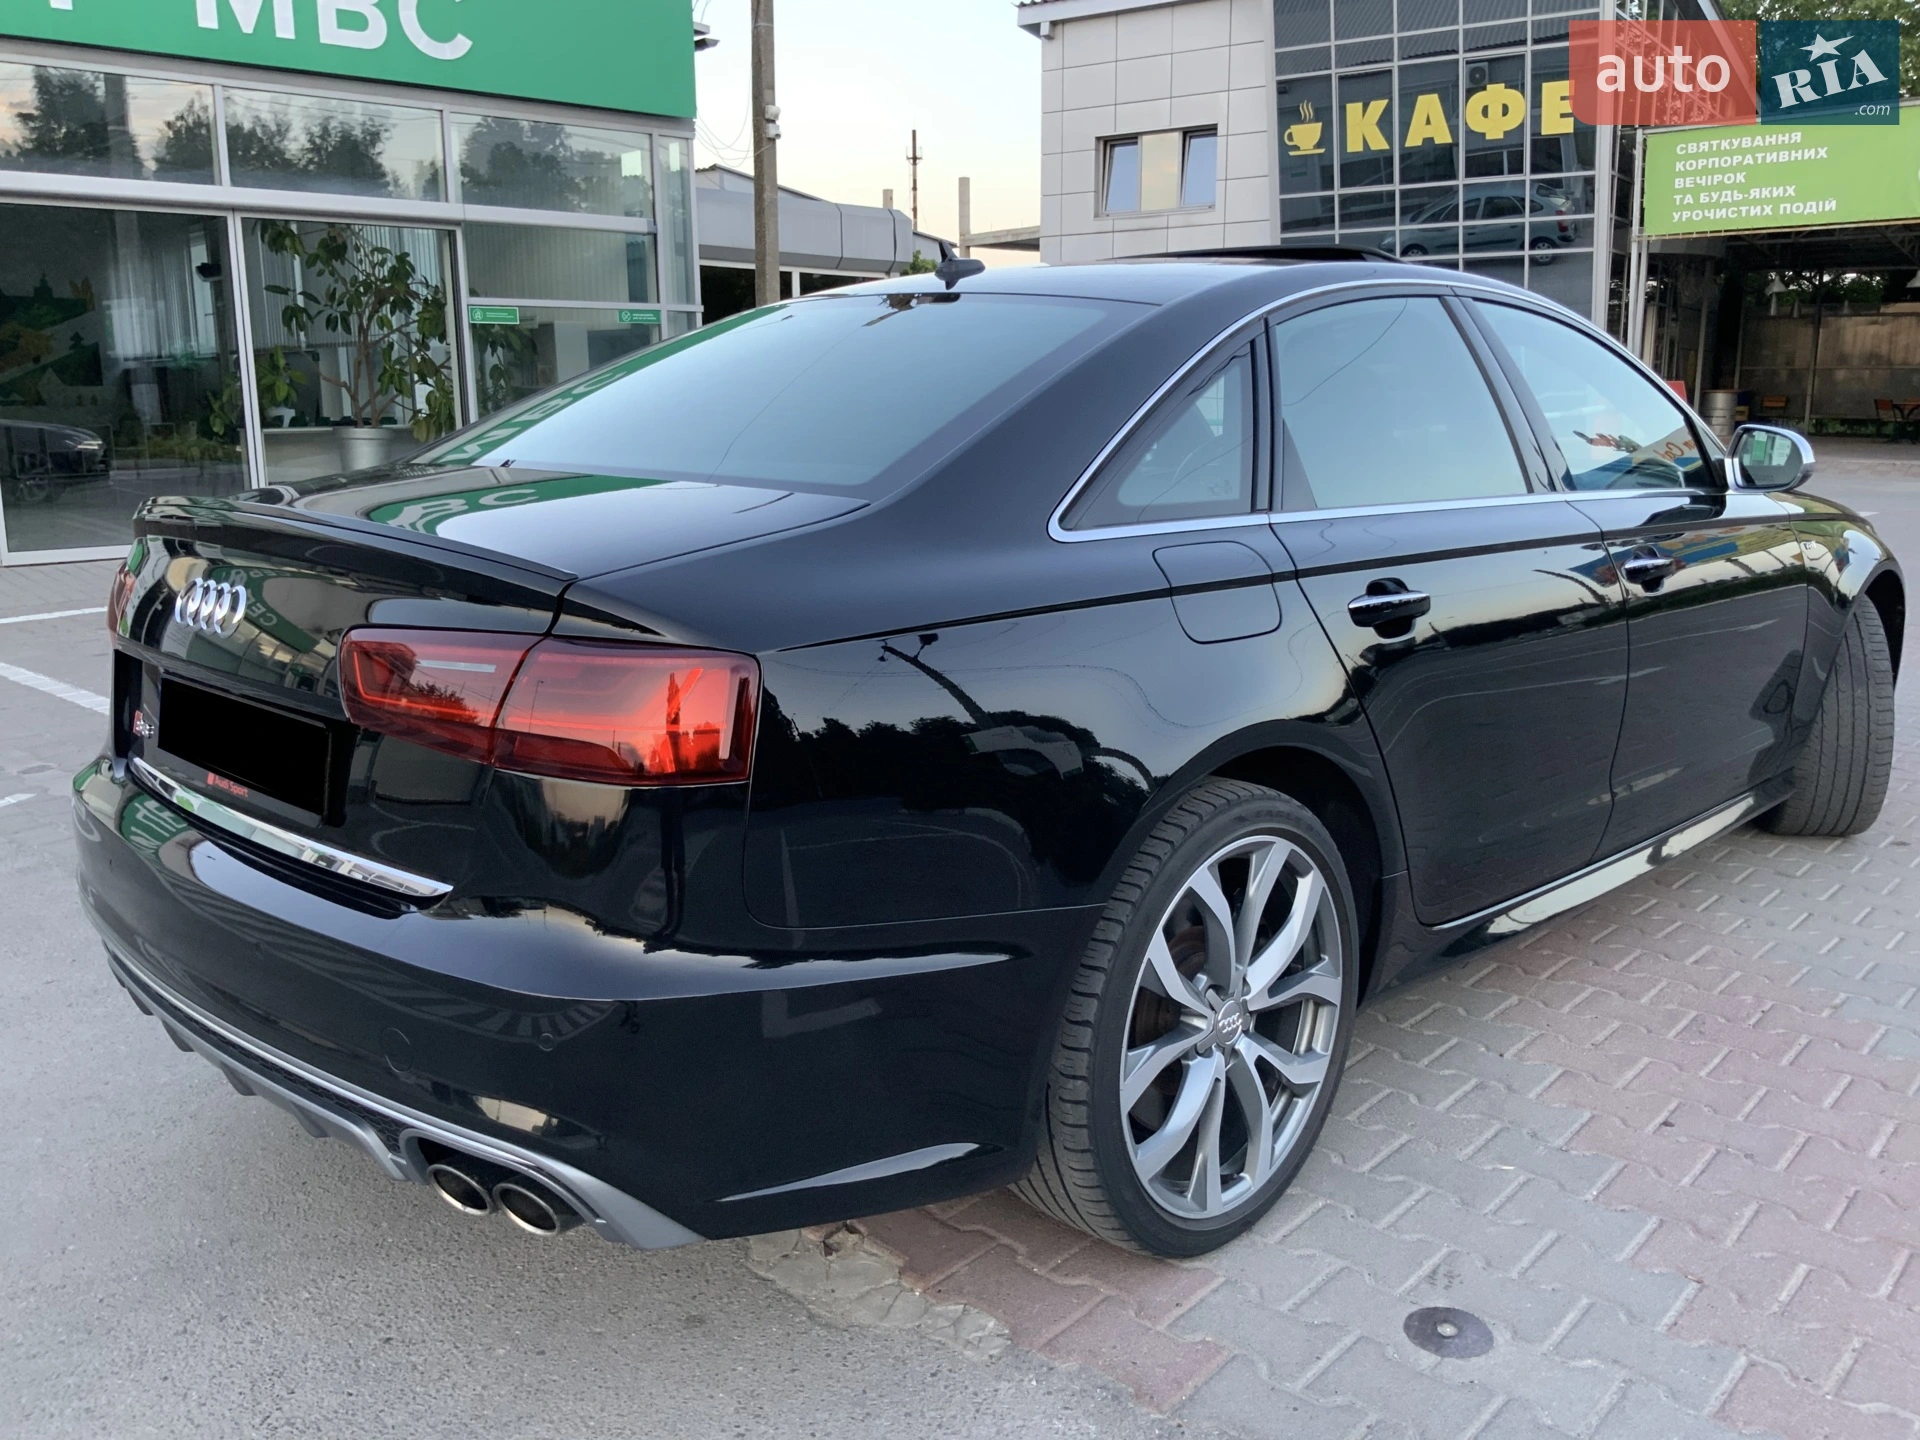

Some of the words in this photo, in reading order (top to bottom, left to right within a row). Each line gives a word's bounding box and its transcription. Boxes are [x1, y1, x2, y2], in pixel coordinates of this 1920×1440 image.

[1345, 79, 1576, 153] КАФЕ
[1676, 131, 1802, 155] СВЯТКУВАННЯ
[1675, 147, 1828, 172] КОРПОРАТИВНИХ
[1674, 172, 1747, 189] ВЕЧІРОК
[1673, 194, 1694, 205] ТА
[1699, 185, 1796, 204] БУДЬ-ЯКИХ
[1672, 204, 1773, 223] УРОЧИСТИХ
[1779, 197, 1837, 215] ПОДІЙ
